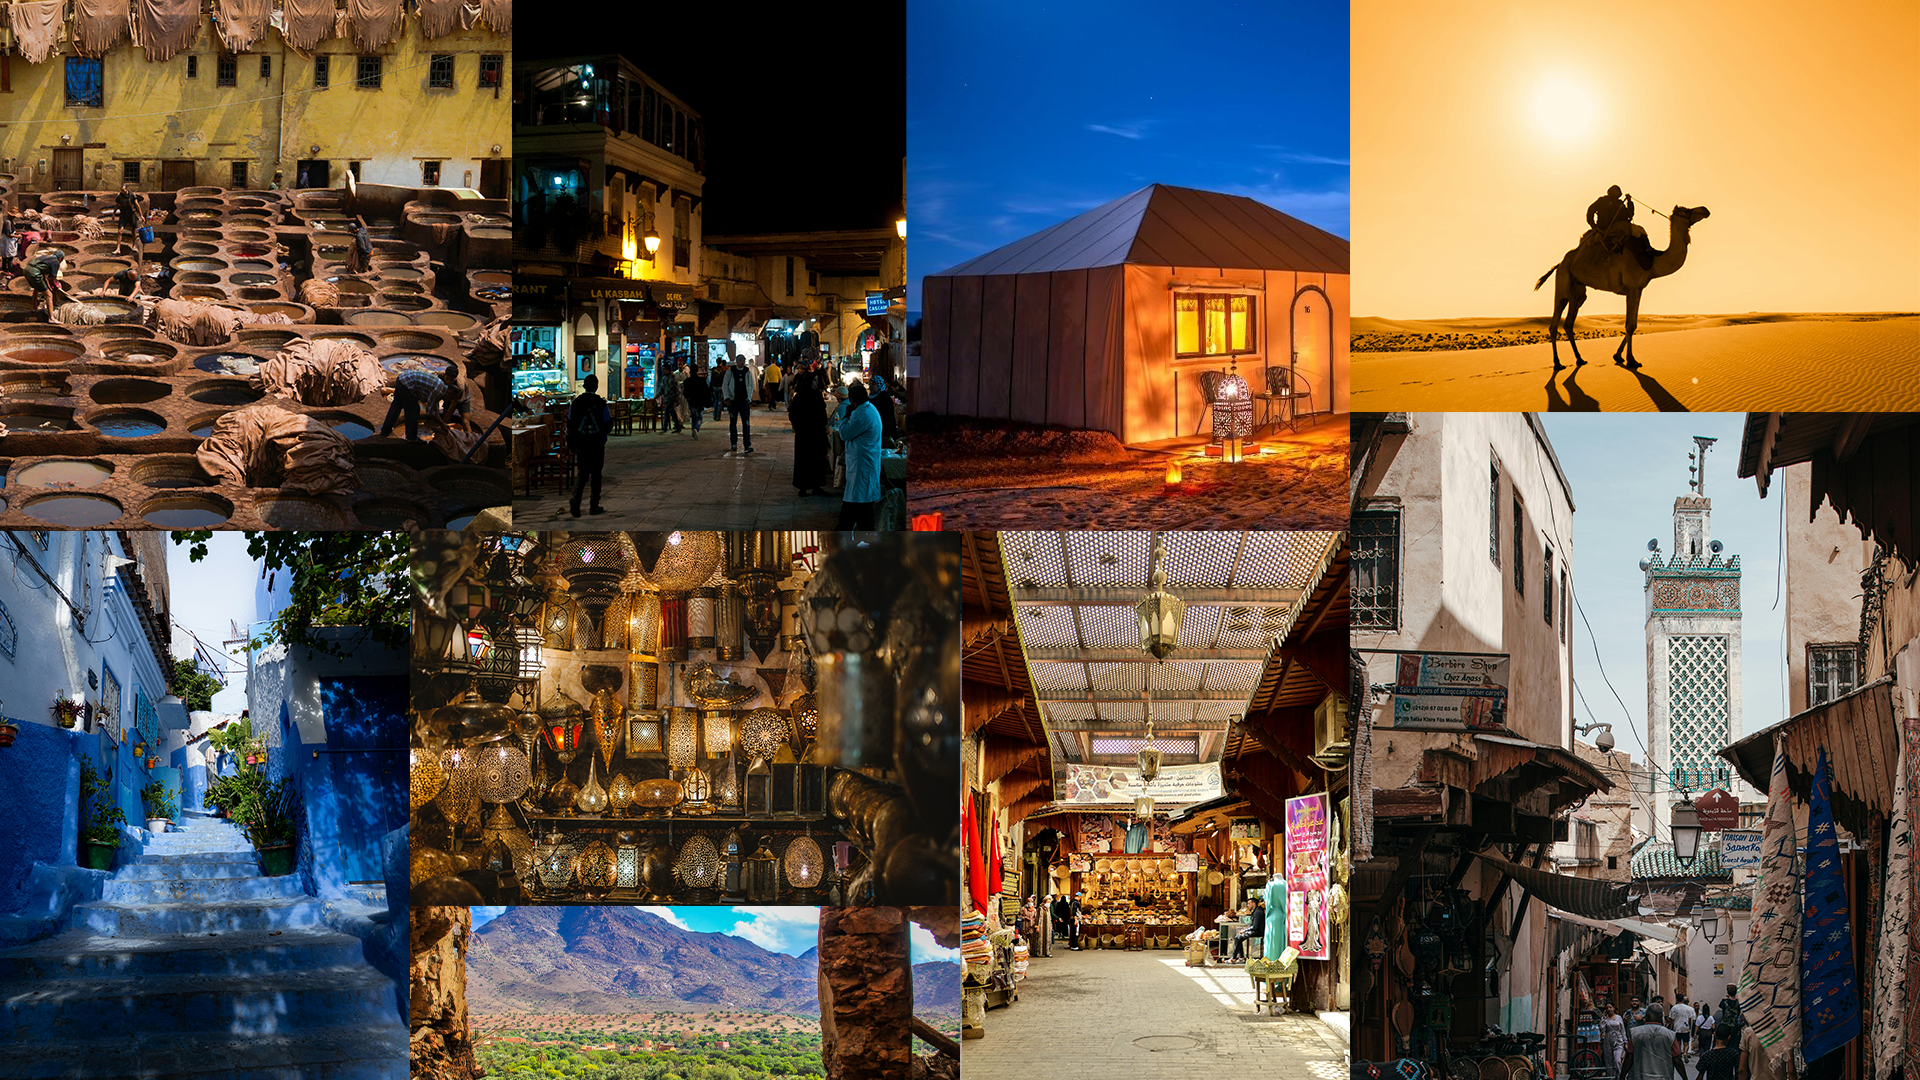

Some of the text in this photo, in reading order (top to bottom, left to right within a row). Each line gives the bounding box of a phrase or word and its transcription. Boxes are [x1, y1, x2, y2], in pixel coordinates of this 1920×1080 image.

[591, 289, 643, 299] LA KASBAH
[1304, 305, 1311, 314] 16
[1427, 656, 1498, 673] Berbère Shop
[1443, 672, 1482, 683] Chez Anass
[1418, 687, 1433, 696] types
[1722, 833, 1747, 842] MAISON
